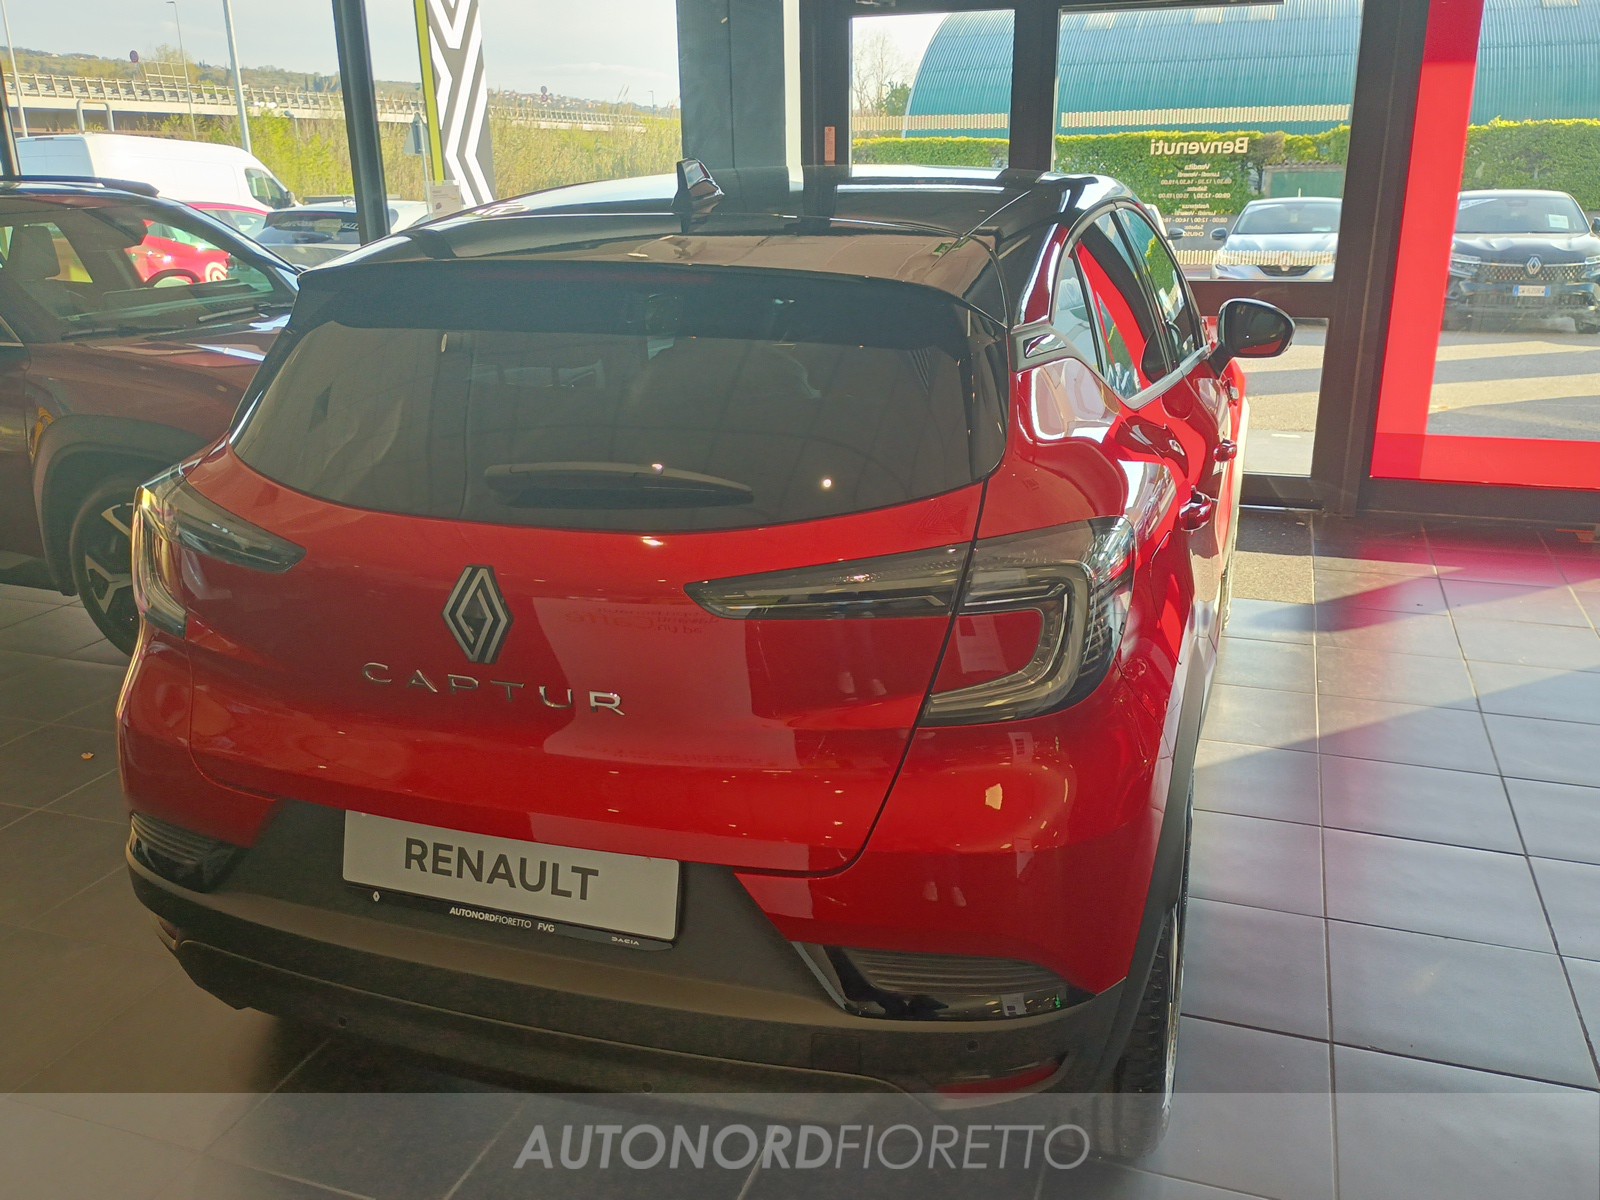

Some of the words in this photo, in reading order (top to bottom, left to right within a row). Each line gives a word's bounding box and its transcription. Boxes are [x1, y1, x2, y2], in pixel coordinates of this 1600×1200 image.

[363, 662, 625, 716] CAPTUR
[405, 837, 599, 900] RENAULT
[449, 906, 532, 929] AUTONORDFIORETTO
[537, 922, 555, 933] FVG
[611, 936, 640, 946] DACIA
